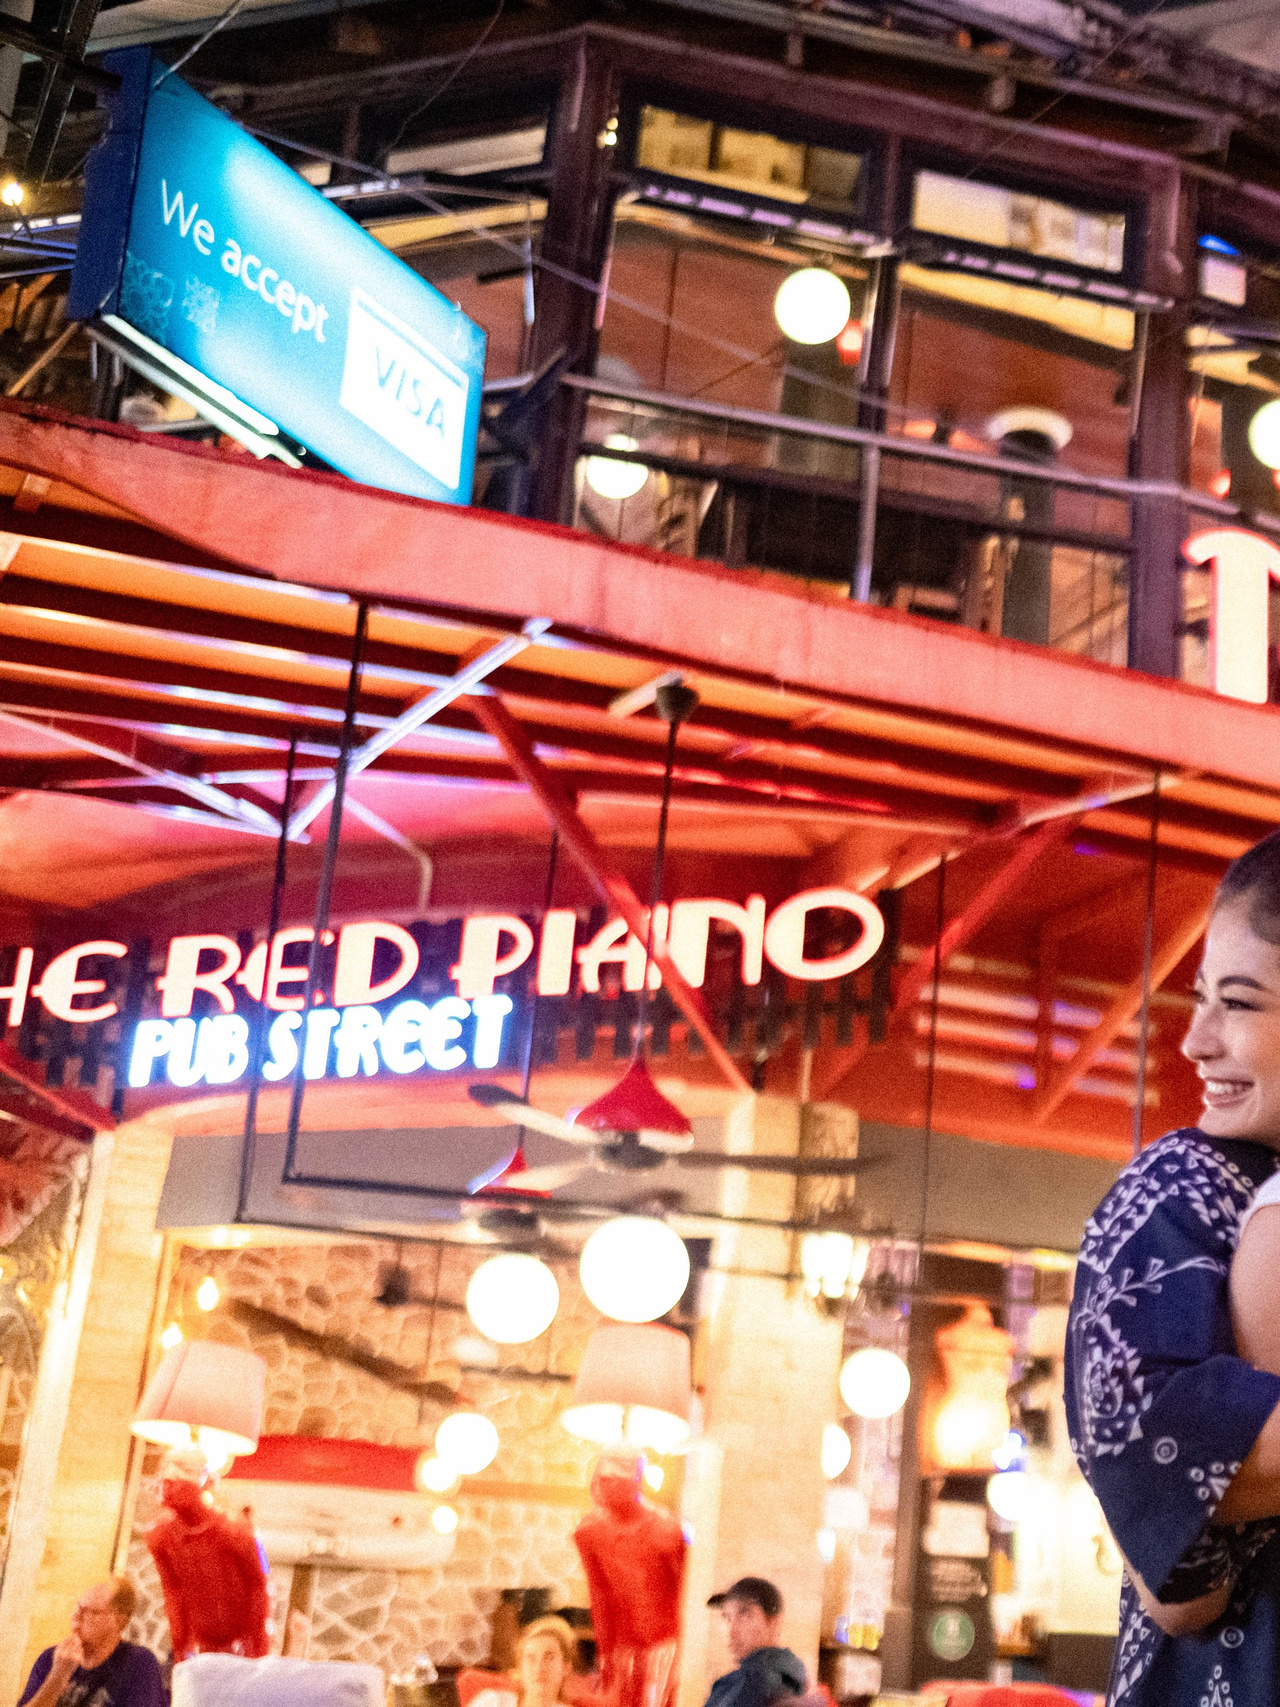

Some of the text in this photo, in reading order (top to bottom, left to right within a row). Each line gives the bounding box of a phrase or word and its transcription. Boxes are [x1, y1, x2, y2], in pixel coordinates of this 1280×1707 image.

[161, 178, 330, 344] We accept
[375, 345, 447, 438] VISA
[156, 921, 420, 1019] RED
[449, 887, 885, 999] PIANO
[128, 993, 514, 1088] PUB STREET
